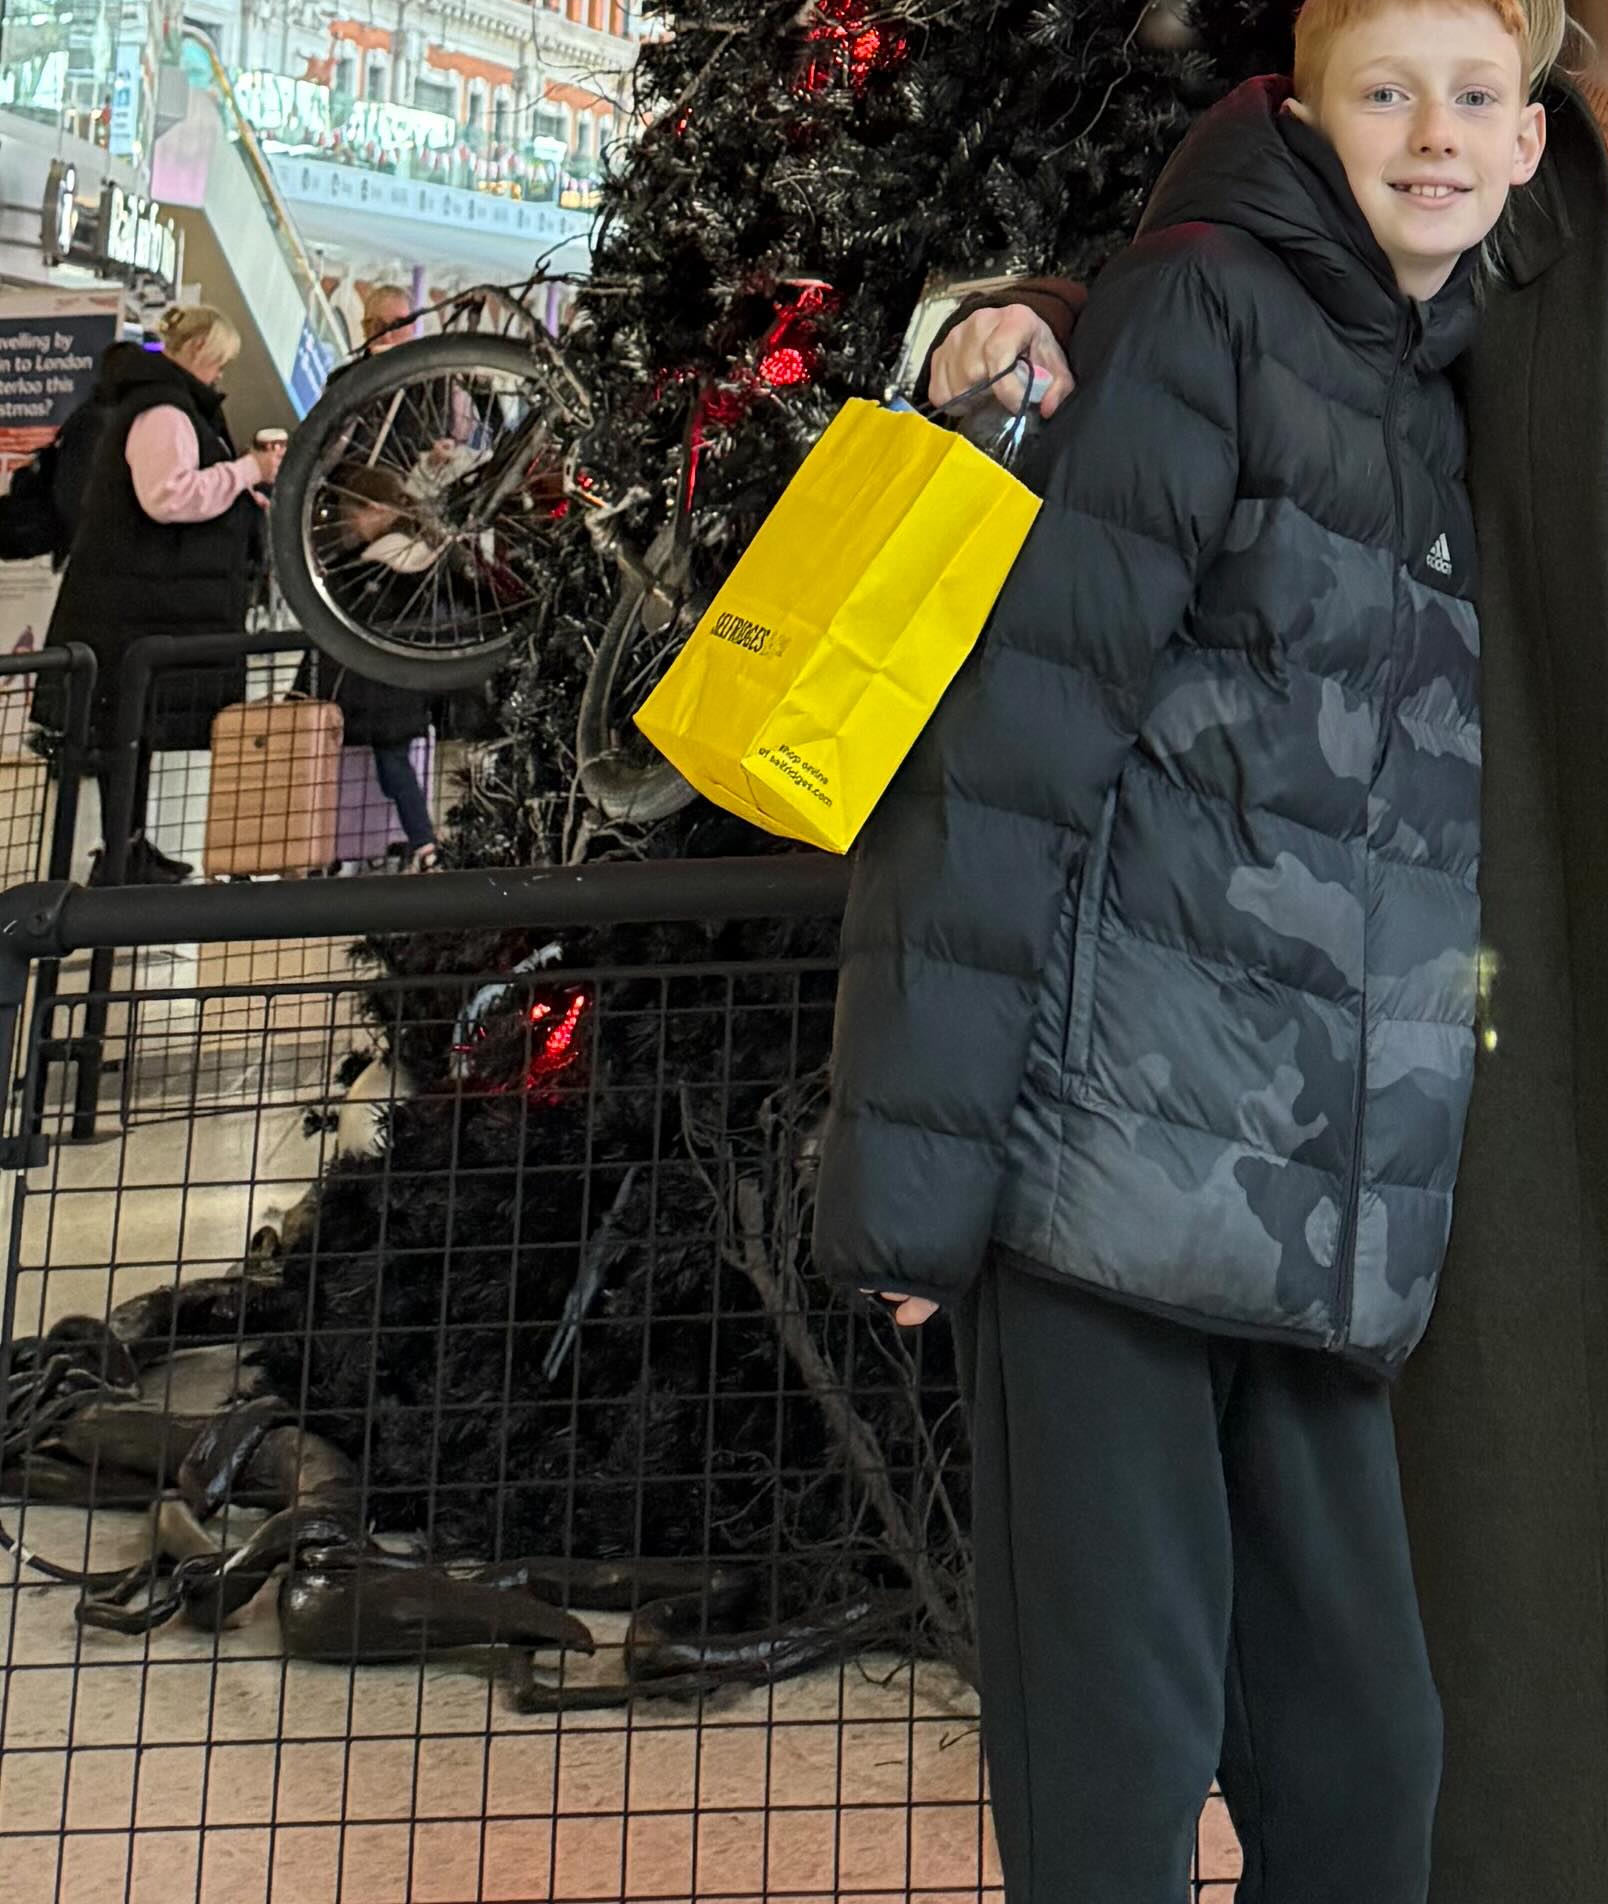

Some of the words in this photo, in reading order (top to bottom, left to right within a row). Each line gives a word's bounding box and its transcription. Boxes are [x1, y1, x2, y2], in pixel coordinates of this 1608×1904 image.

[53, 330, 75, 353] by
[14, 356, 33, 373] to
[35, 352, 94, 373] London
[45, 374, 75, 394] this
[0, 397, 54, 419] stmas?
[710, 611, 771, 653] SELFRIDGES
[802, 762, 829, 785] online
